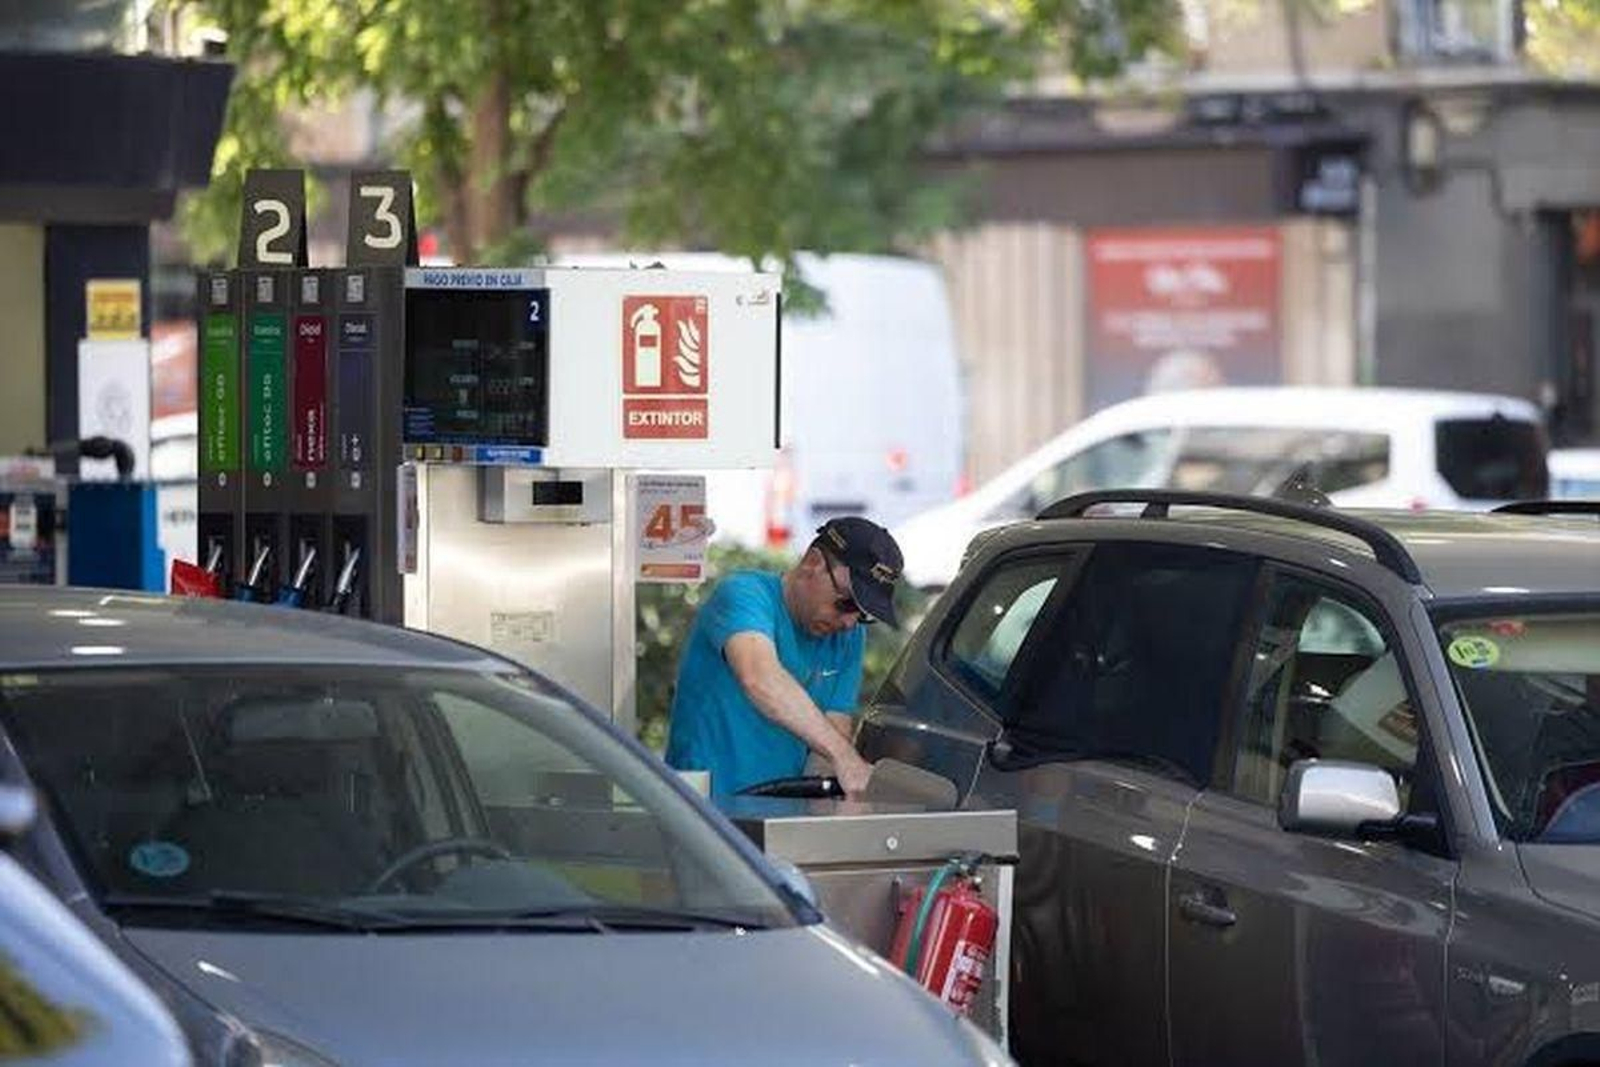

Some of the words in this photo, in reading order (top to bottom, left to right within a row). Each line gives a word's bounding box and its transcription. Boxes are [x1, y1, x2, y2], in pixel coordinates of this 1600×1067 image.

[253, 198, 293, 264] 2
[360, 185, 403, 250] 3
[529, 300, 541, 322] 2
[628, 410, 704, 426] EXTINTOR
